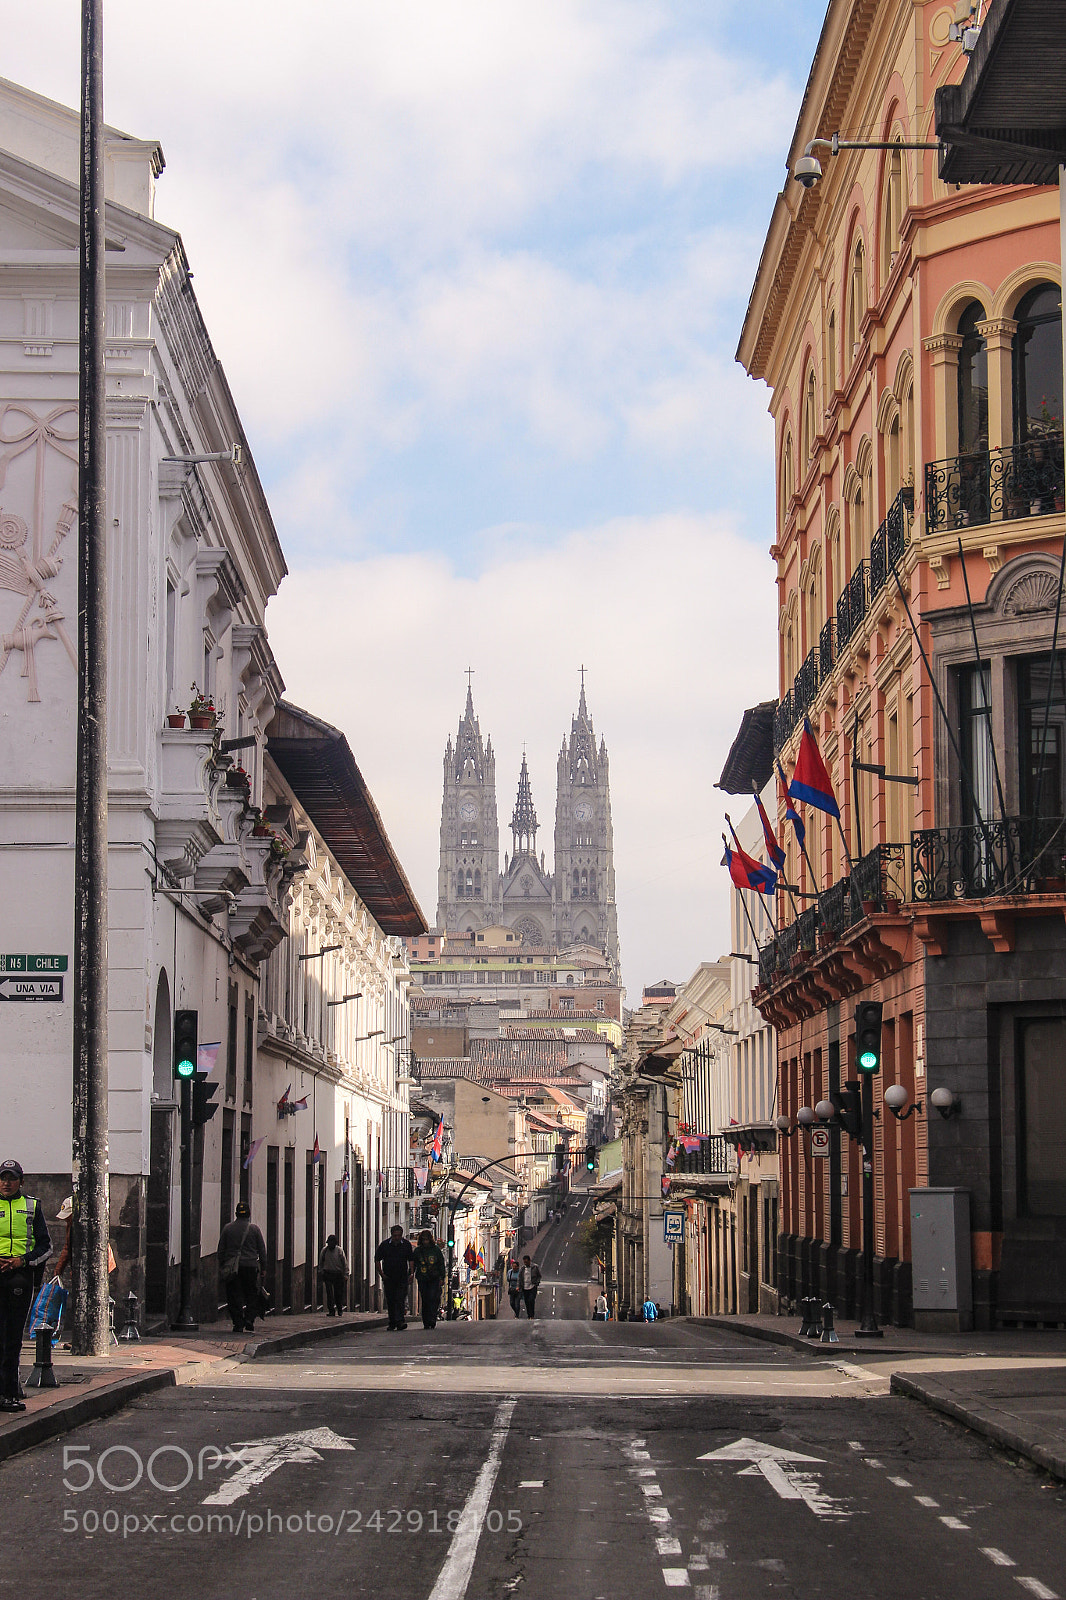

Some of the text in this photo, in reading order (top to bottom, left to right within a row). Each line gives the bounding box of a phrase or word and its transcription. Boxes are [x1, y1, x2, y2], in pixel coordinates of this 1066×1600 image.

[10, 957, 22, 969] N5
[35, 957, 60, 969] CHILE
[15, 984, 55, 993] UNA VIA
